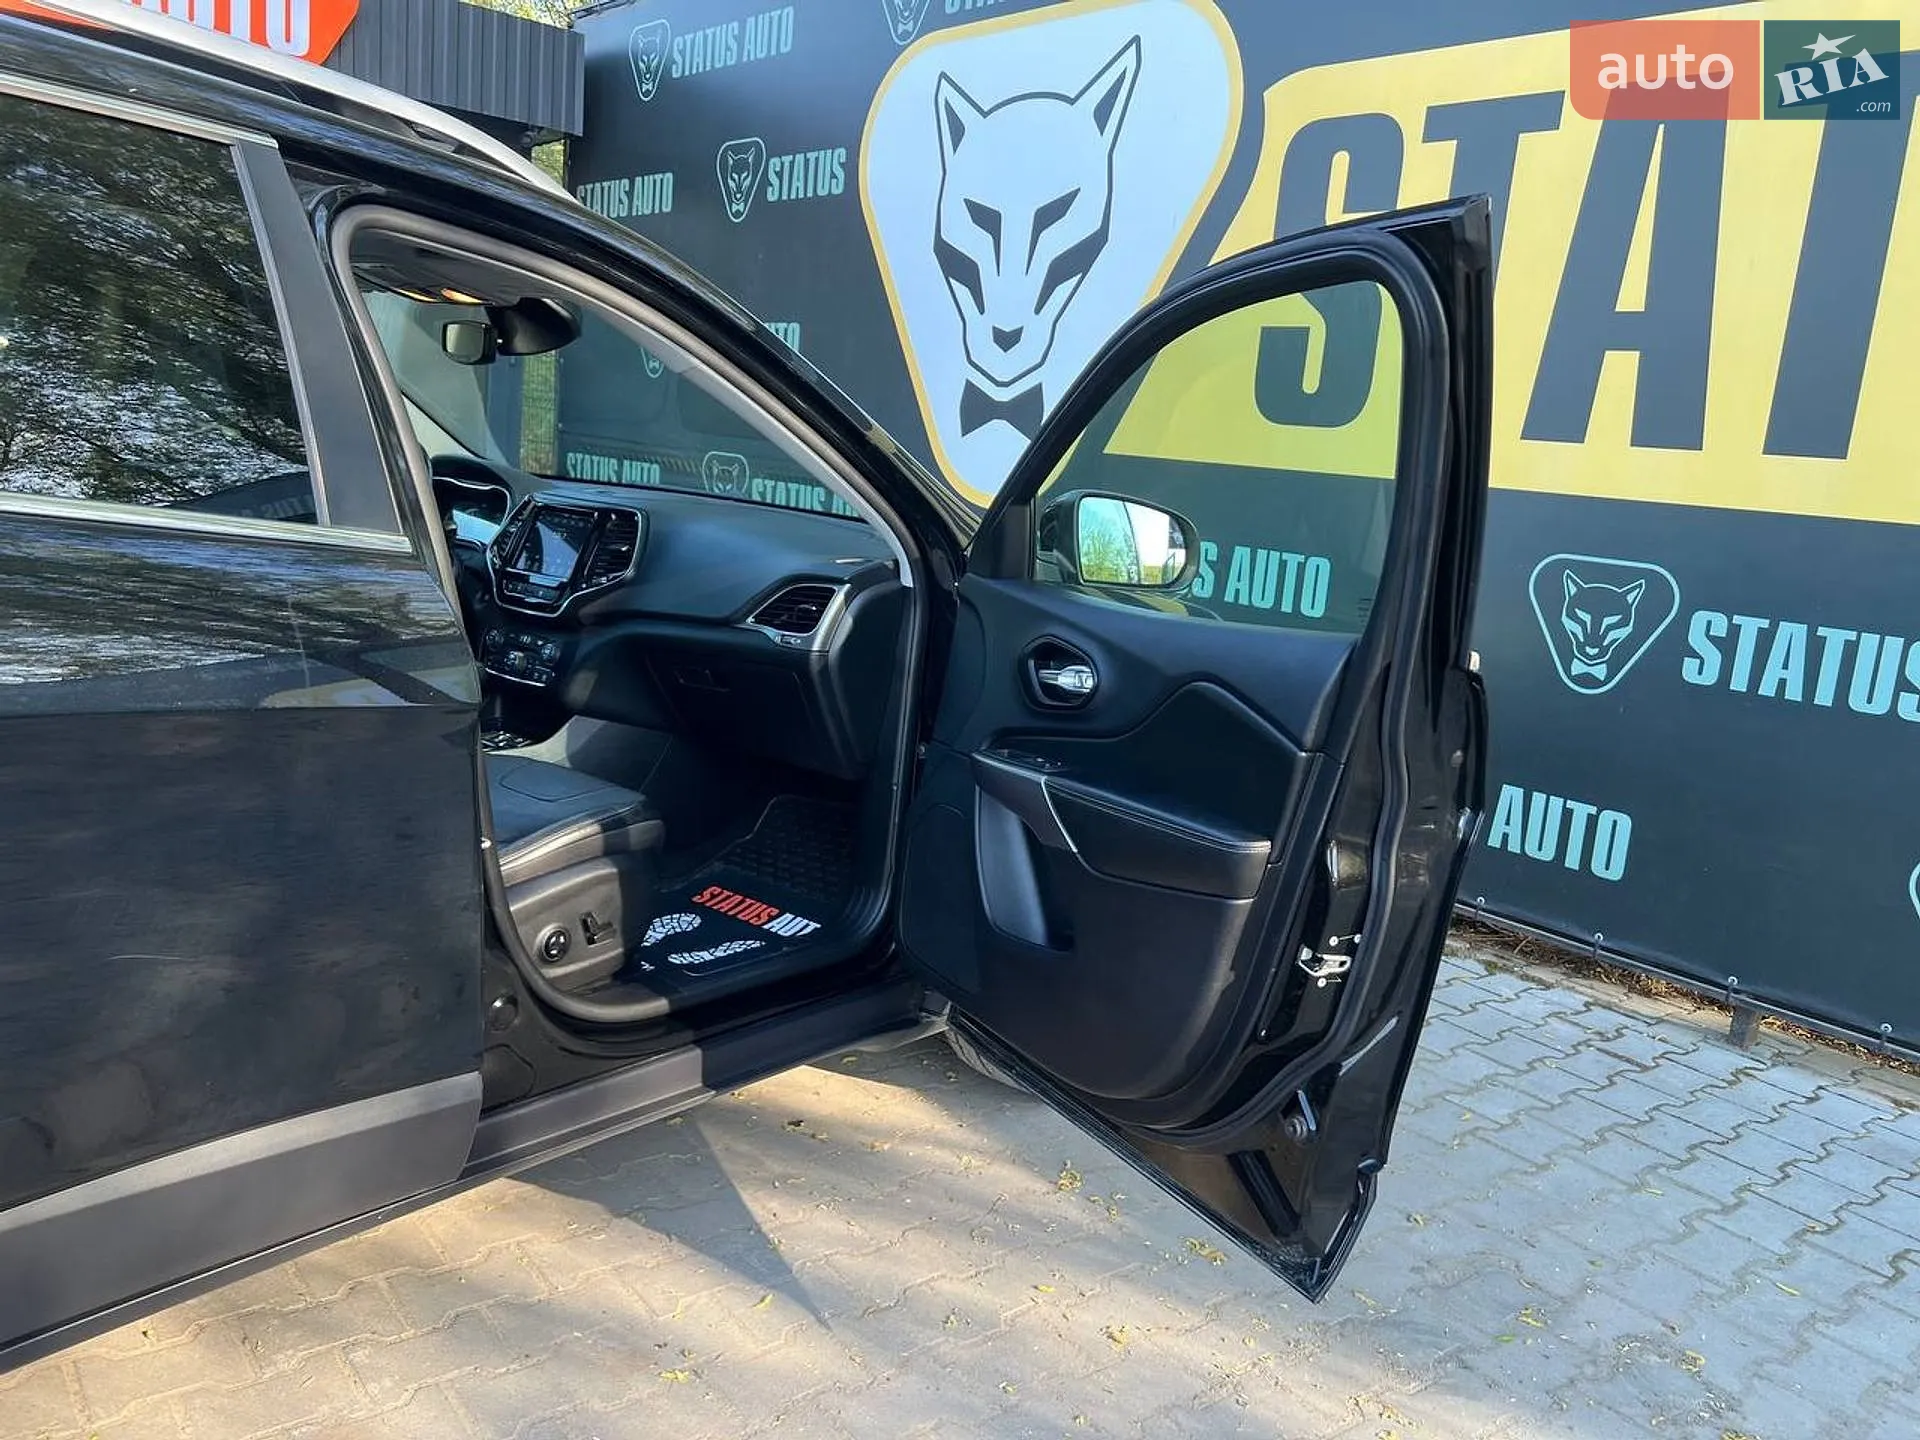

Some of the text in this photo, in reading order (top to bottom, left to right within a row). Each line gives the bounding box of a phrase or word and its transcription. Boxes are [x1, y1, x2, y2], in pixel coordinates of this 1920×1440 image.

[671, 6, 794, 78] STATUS AUTO
[576, 172, 674, 219] STATUS AUTO
[766, 147, 847, 202] STATUS
[1224, 545, 1331, 618] AUTO
[1487, 783, 1632, 882] AUTO
[692, 886, 780, 926] STATUS
